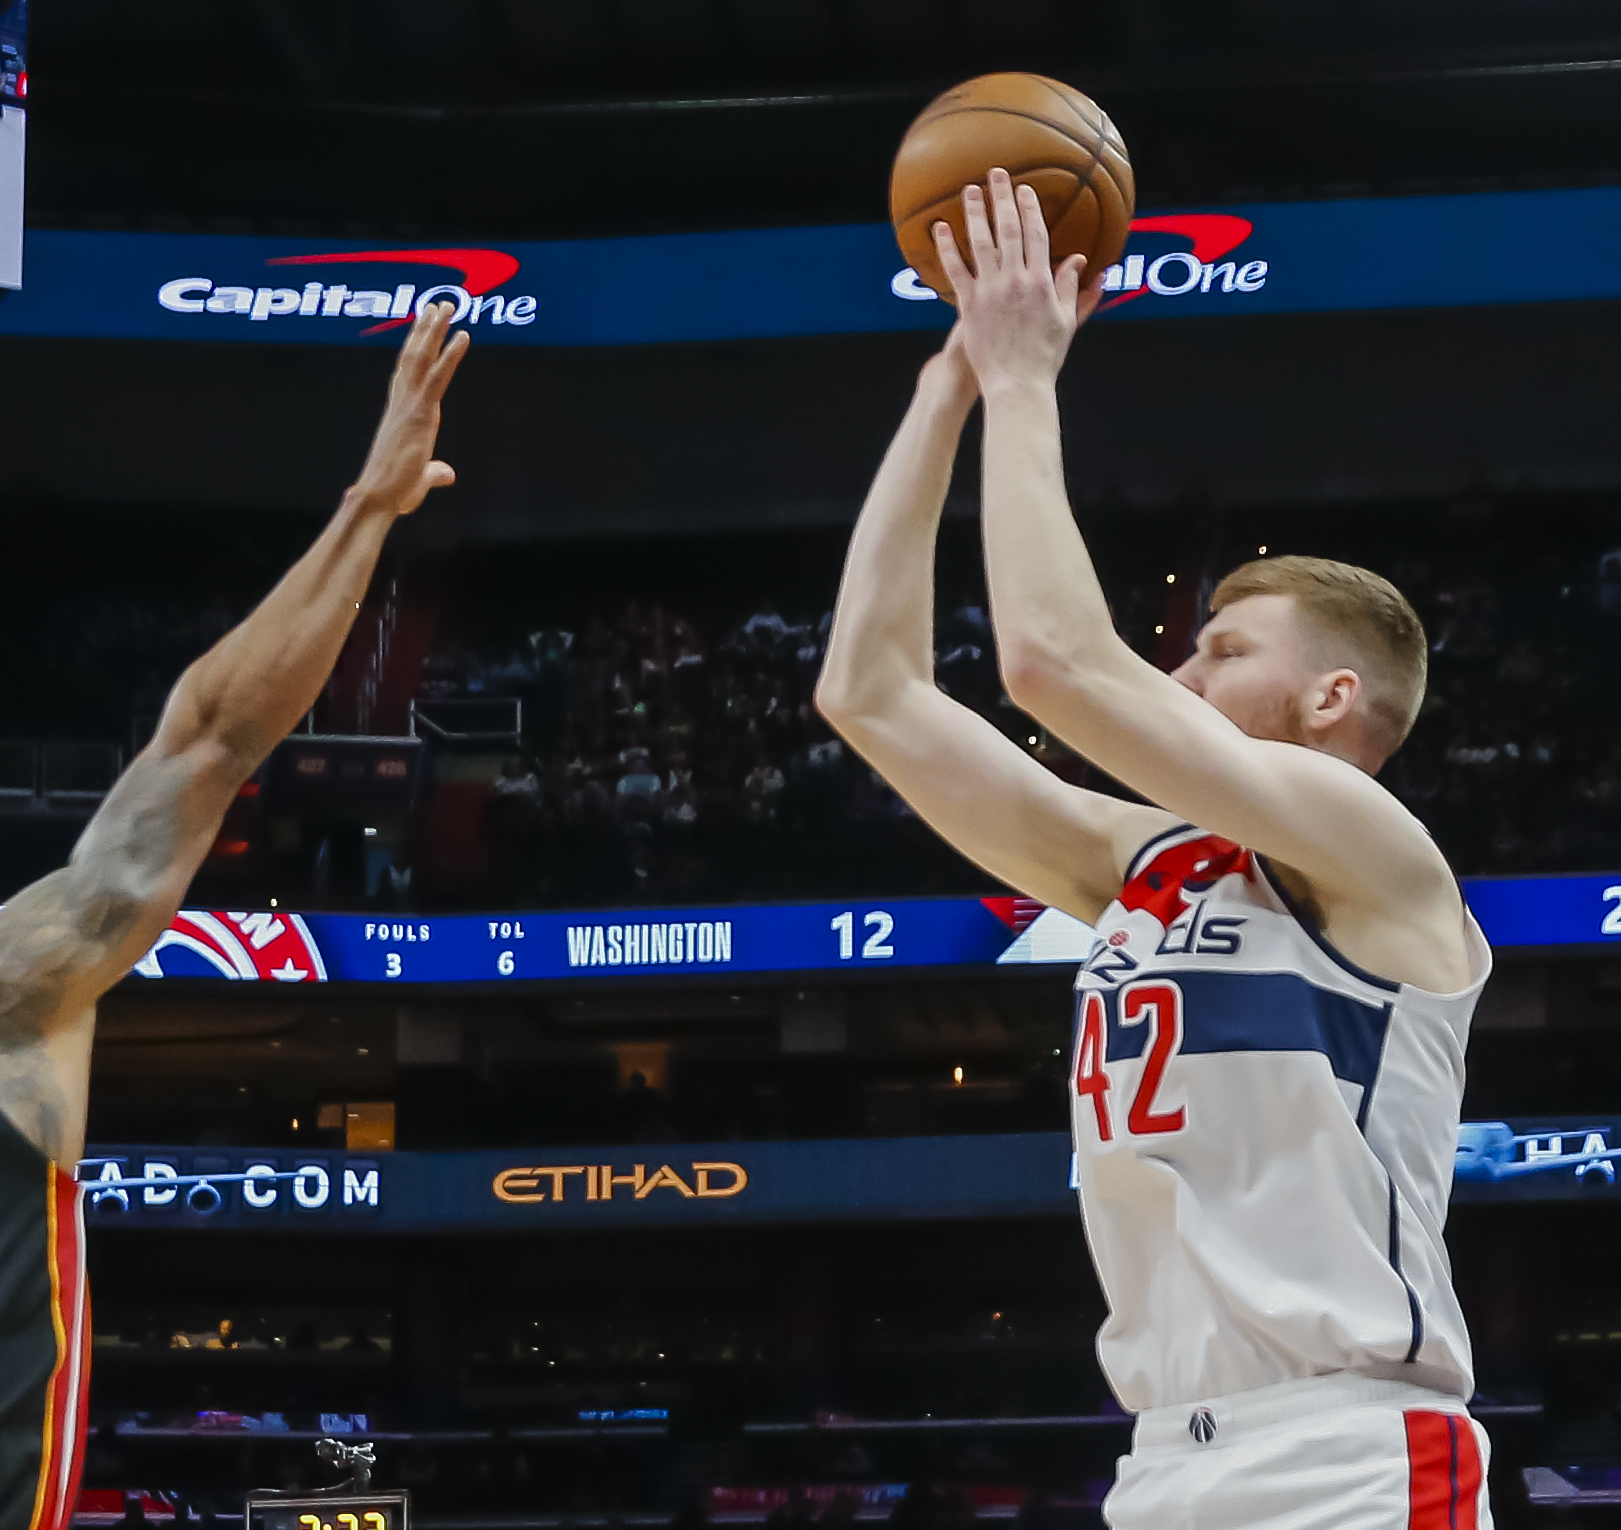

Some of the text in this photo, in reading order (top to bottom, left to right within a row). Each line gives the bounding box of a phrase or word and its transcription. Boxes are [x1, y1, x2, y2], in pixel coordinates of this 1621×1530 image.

[364, 921, 432, 943] FOULS
[487, 920, 526, 940] TOL
[566, 910, 896, 968] WASHINGTON 12
[384, 952, 403, 978] 3
[497, 950, 515, 976] 6
[1075, 978, 1187, 1144] 42
[492, 1161, 748, 1203] ETIHAD
